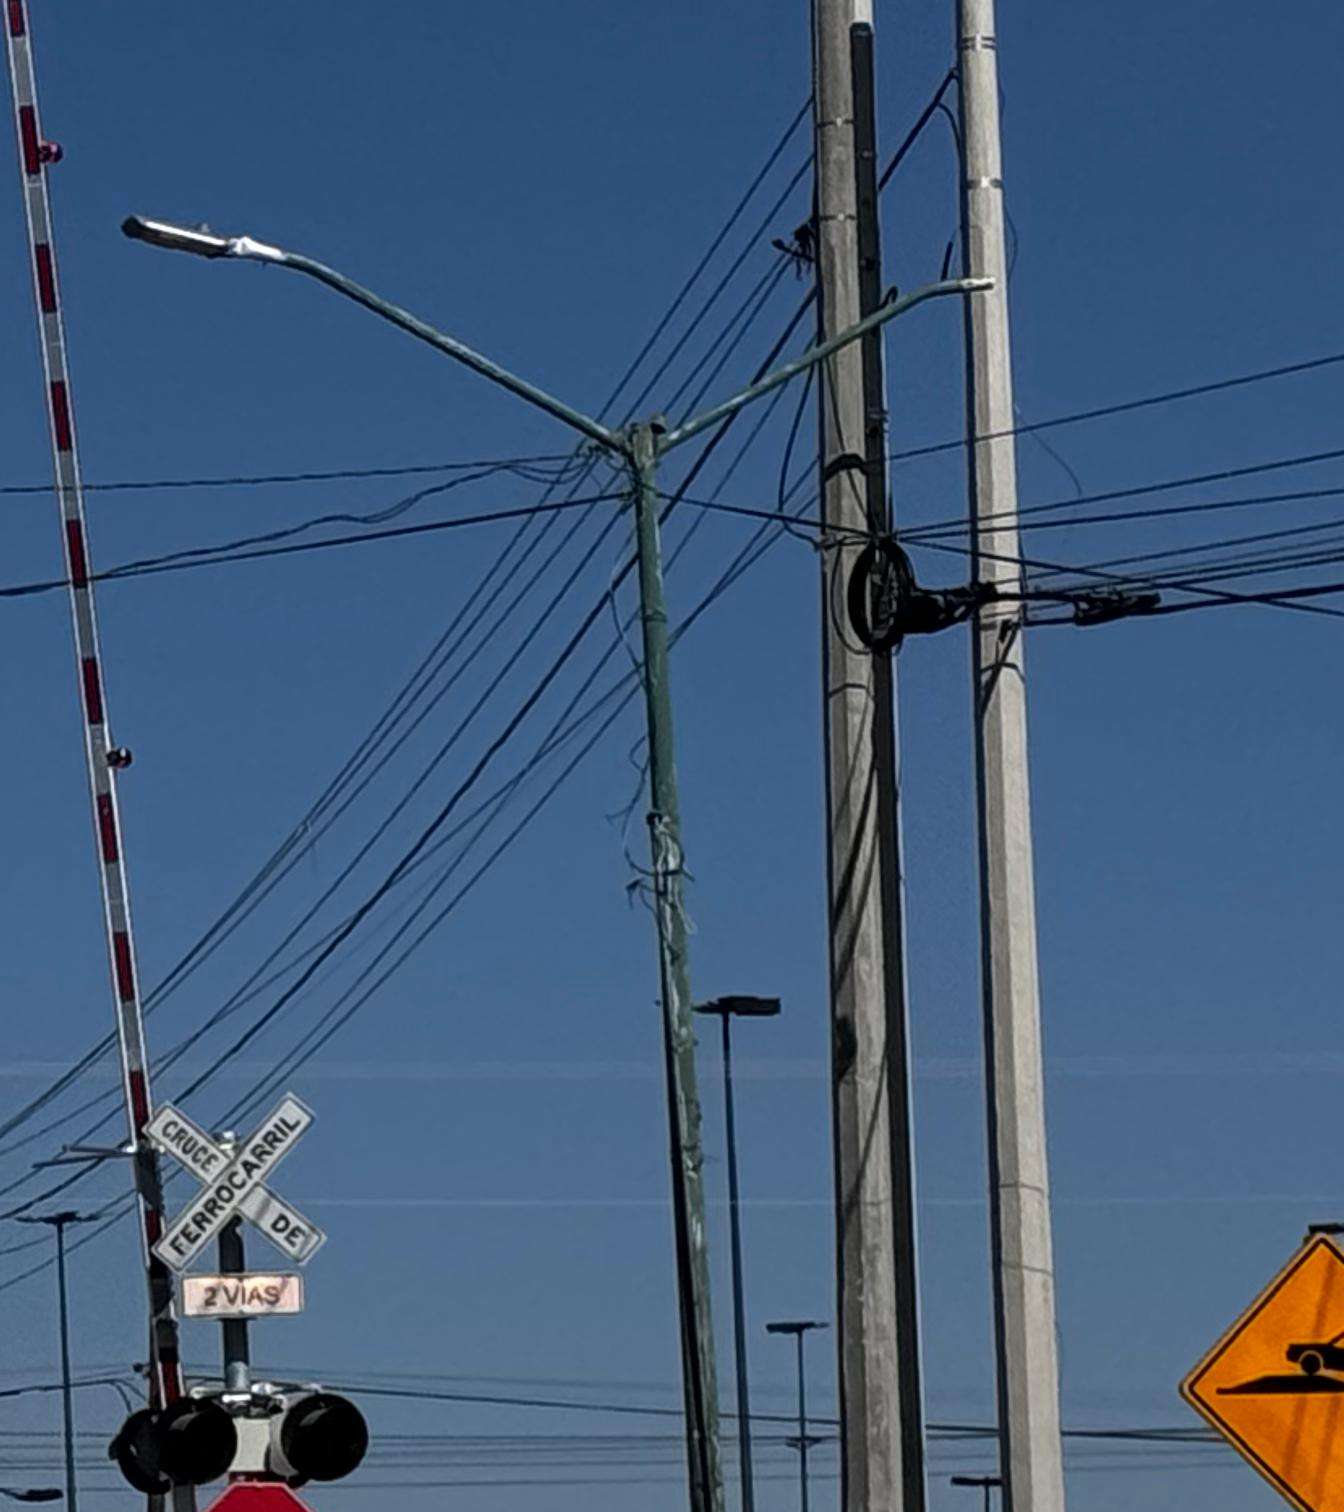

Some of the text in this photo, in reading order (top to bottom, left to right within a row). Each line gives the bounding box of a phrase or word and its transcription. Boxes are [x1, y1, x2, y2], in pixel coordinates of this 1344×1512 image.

[161, 1120, 219, 1172] CRUCE
[169, 1117, 301, 1257] FERROCARRIL
[270, 1213, 306, 1248] DE
[222, 1283, 281, 1305] VIAS
